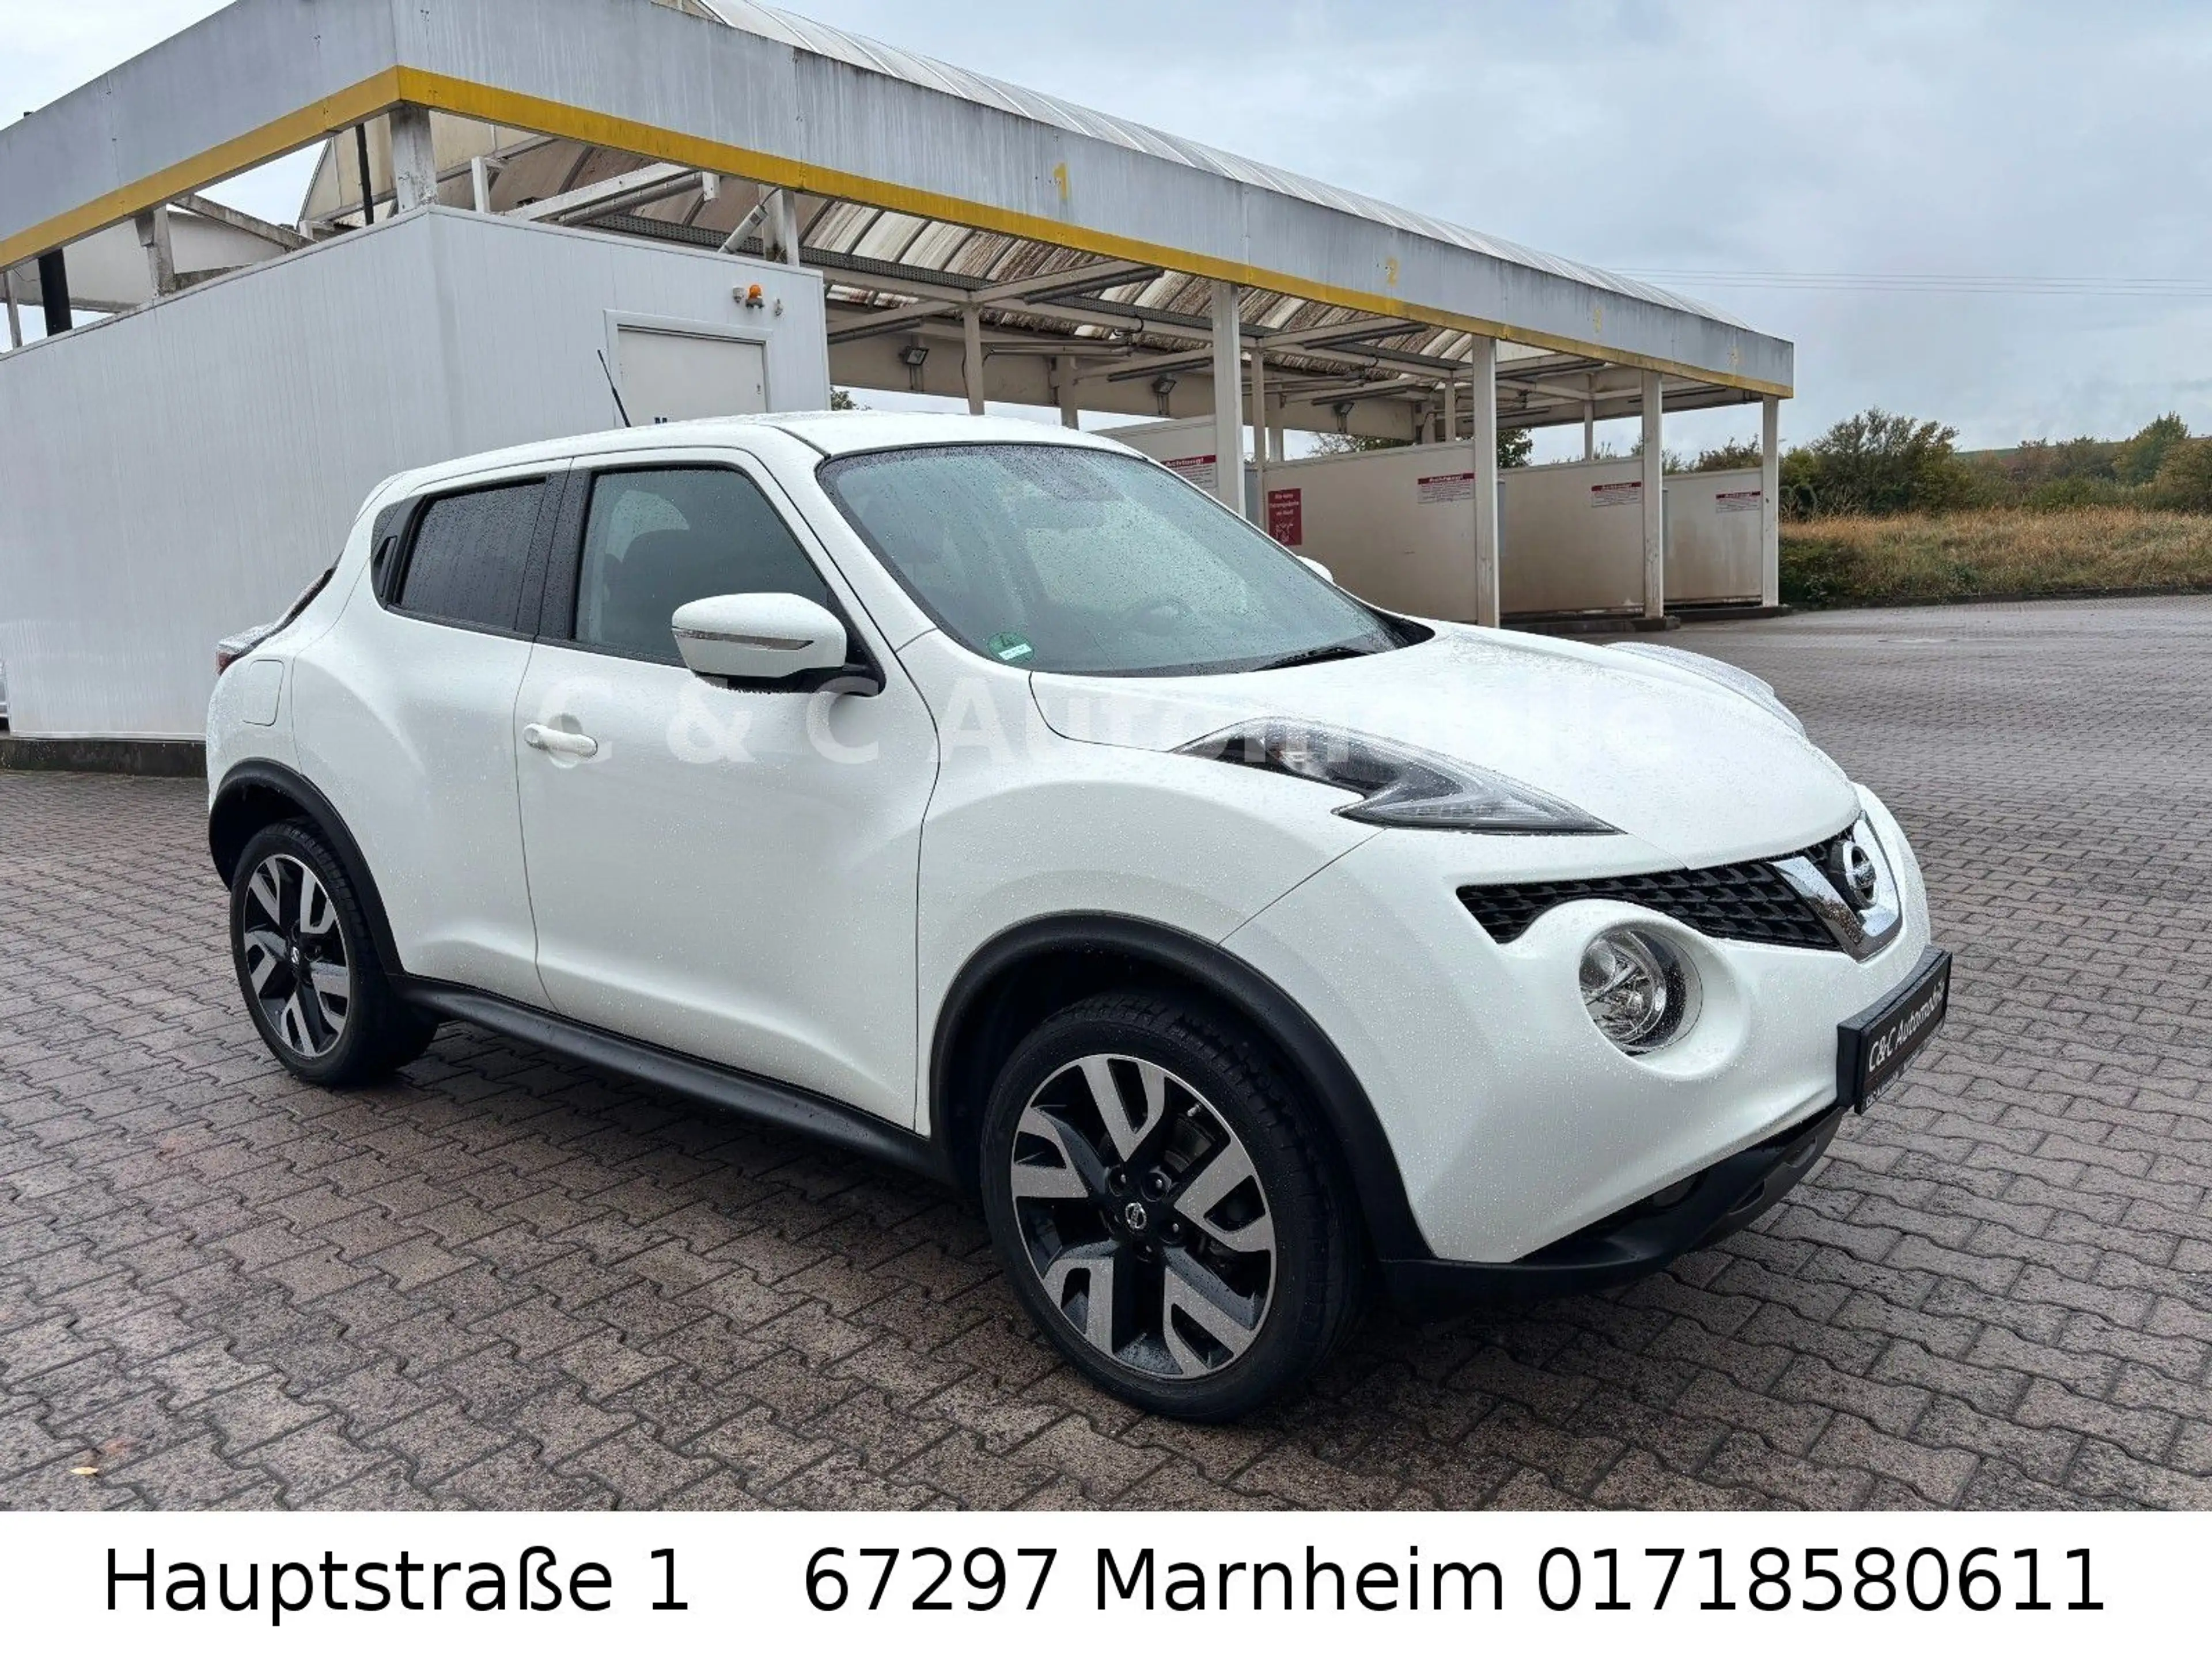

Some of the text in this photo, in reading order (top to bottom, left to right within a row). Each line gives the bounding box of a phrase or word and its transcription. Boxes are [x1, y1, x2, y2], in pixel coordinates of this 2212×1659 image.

[1053, 162, 1067, 199] 1
[1385, 256, 1399, 286] 2
[1869, 1026, 1896, 1073] C&C
